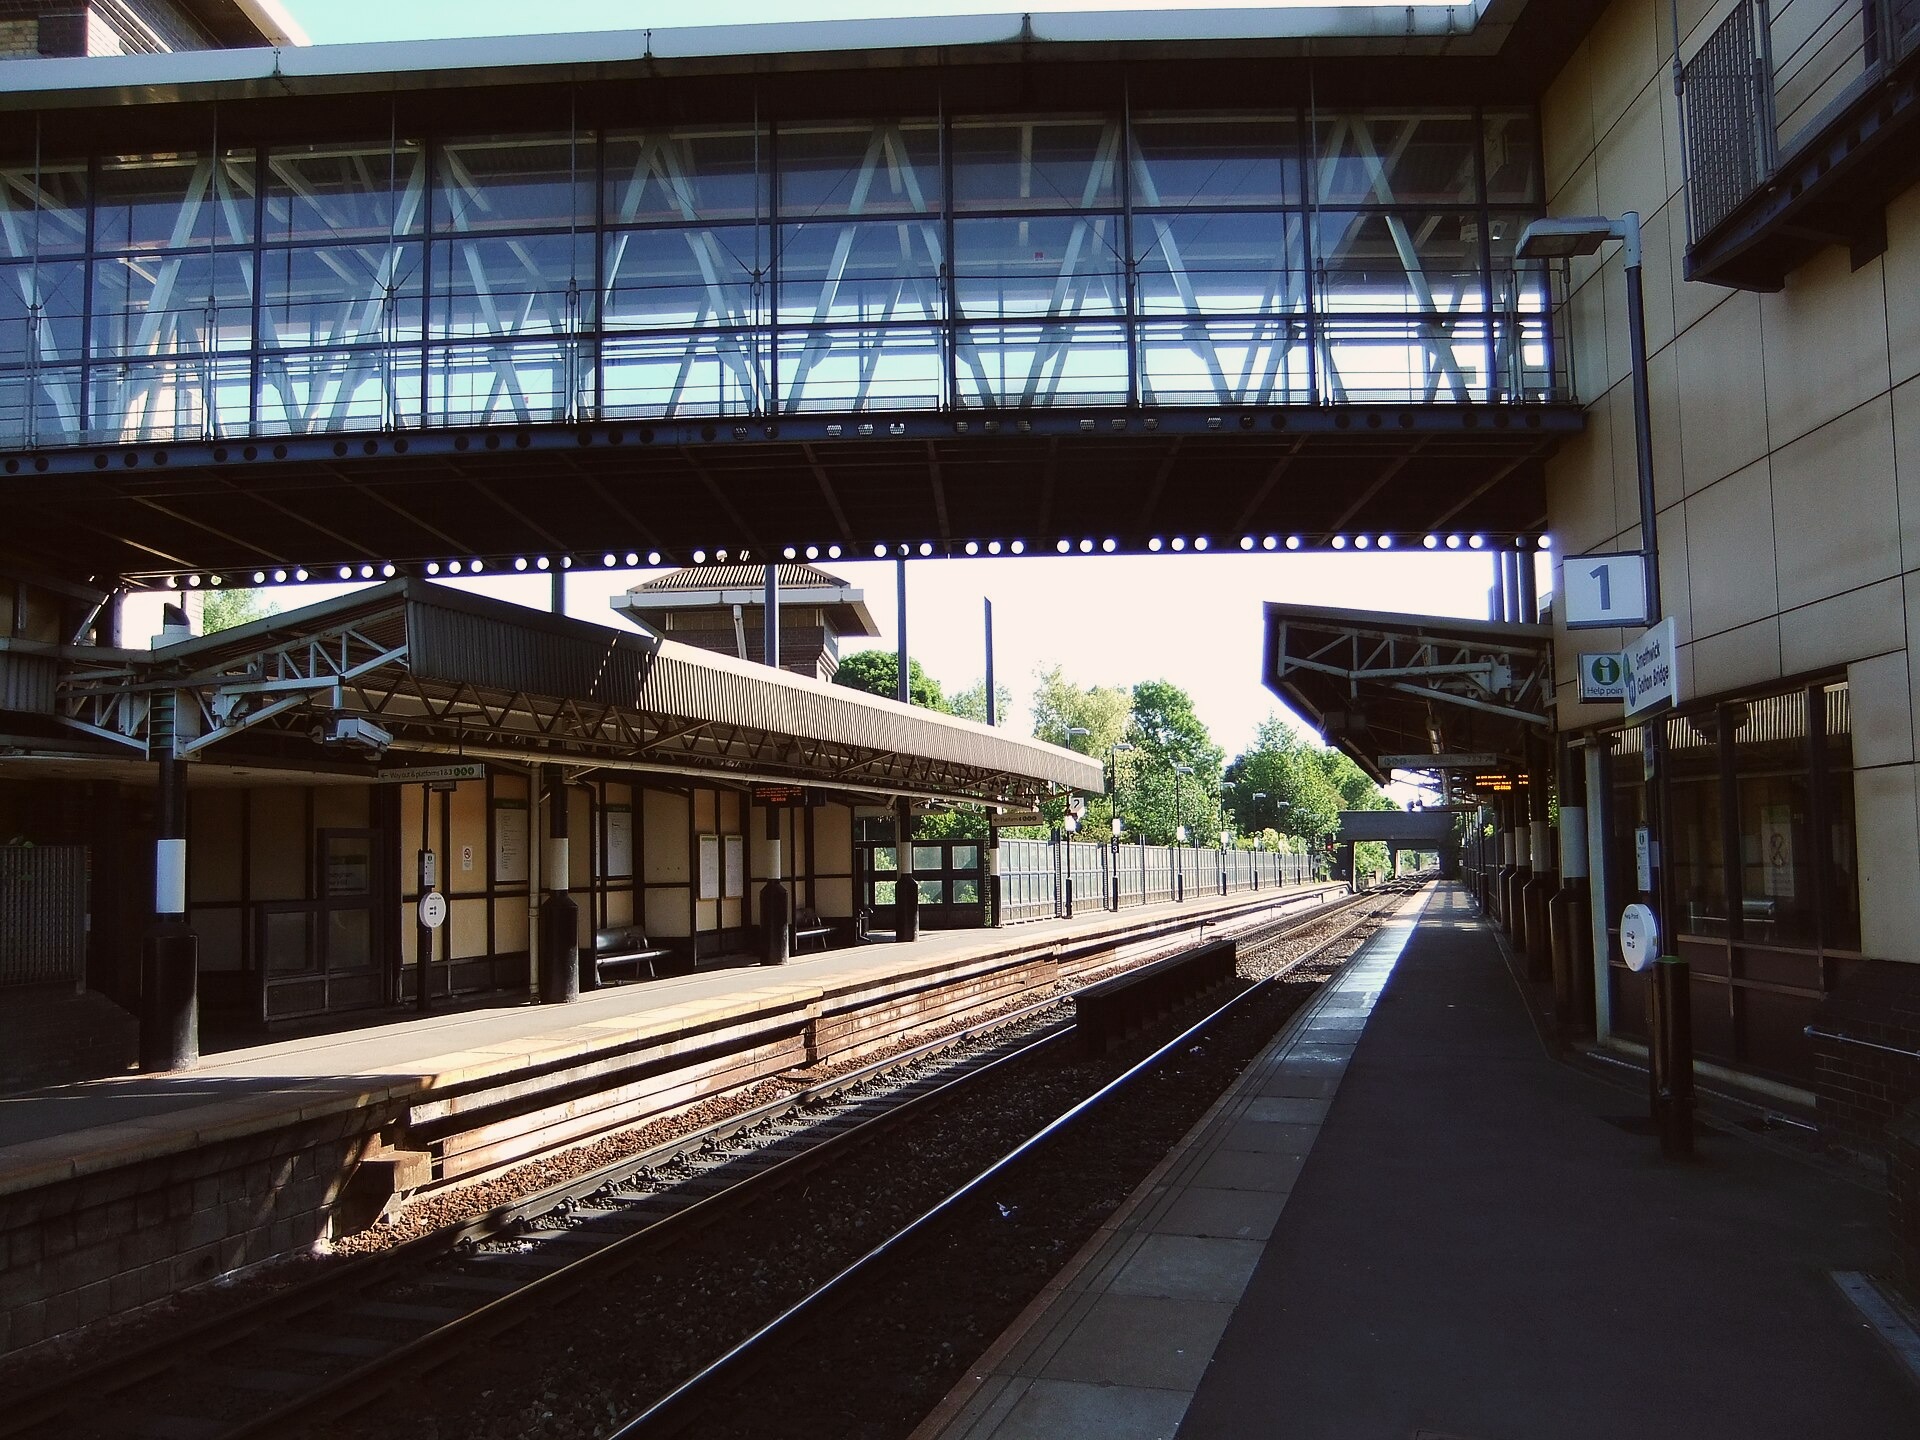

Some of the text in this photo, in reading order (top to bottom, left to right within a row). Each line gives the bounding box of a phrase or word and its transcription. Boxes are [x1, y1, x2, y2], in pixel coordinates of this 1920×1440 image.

[1589, 564, 1611, 611] 1
[1635, 639, 1661, 671] Smethwick
[1587, 686, 1623, 696] Help poin
[1637, 664, 1669, 695] Galton Bridge
